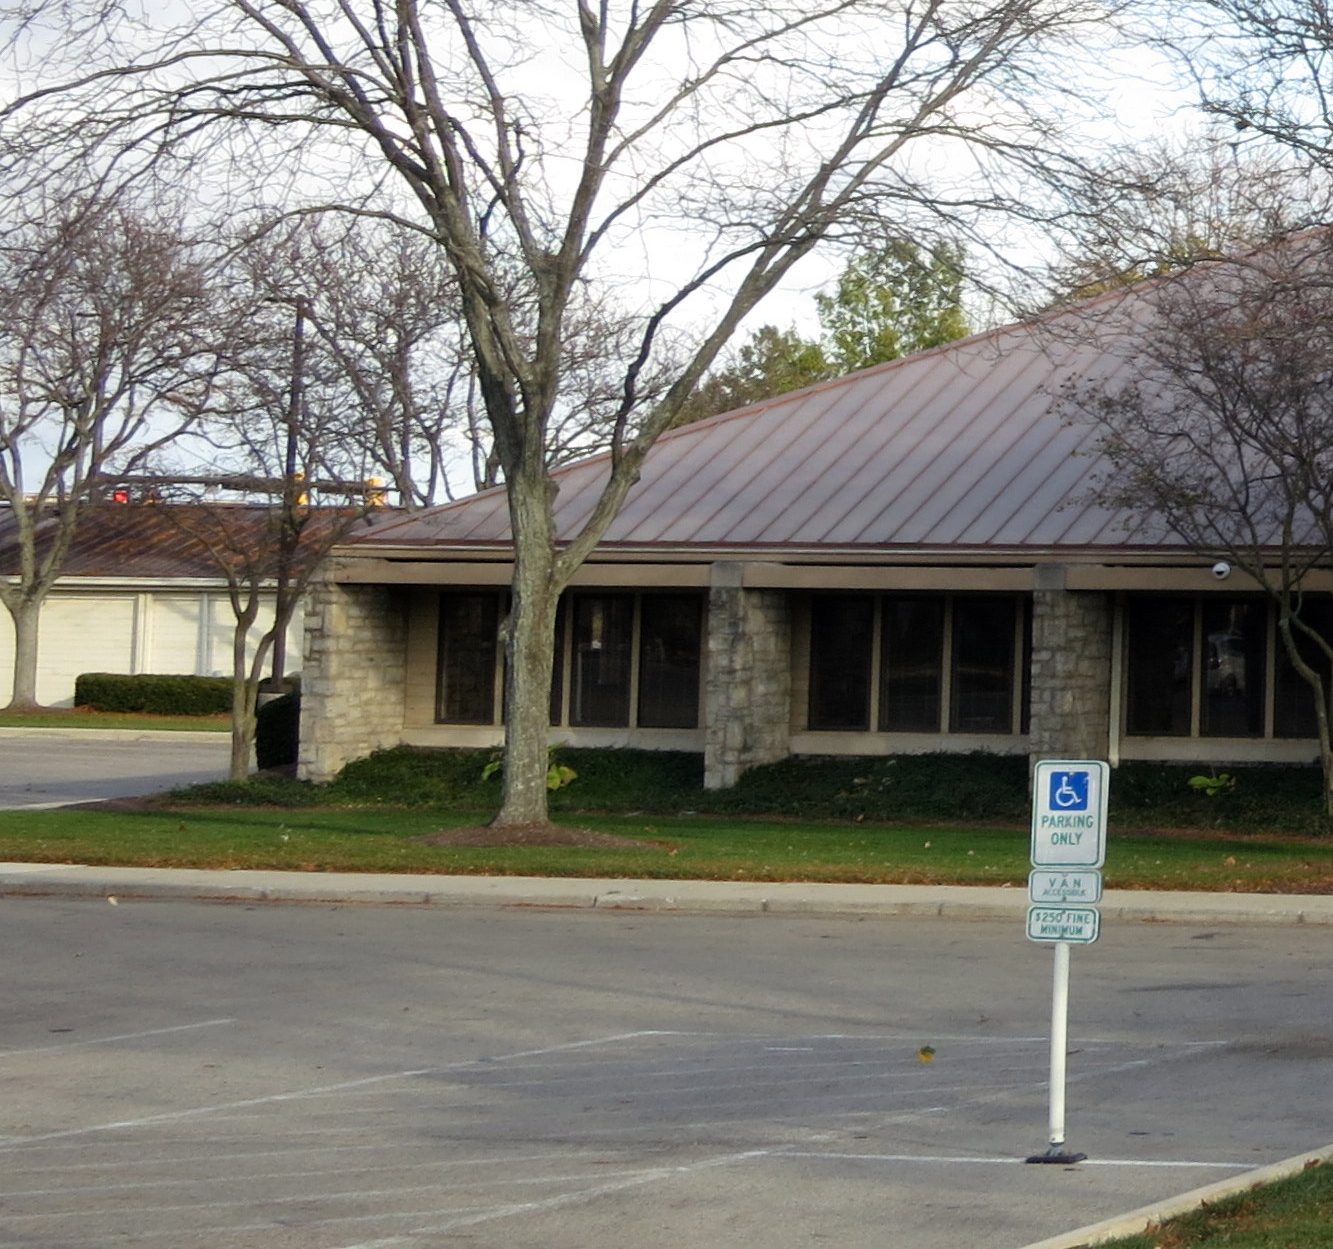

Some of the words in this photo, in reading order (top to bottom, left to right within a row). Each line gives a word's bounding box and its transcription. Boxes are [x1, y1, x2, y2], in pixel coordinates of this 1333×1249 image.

[1041, 815, 1093, 828] PARKING
[1051, 832, 1083, 845] ONLY
[1042, 888, 1086, 896] ACCESLE
[1035, 912, 1062, 923] $250
[1066, 913, 1091, 924] FINE
[1040, 924, 1083, 935] MINIMUM
